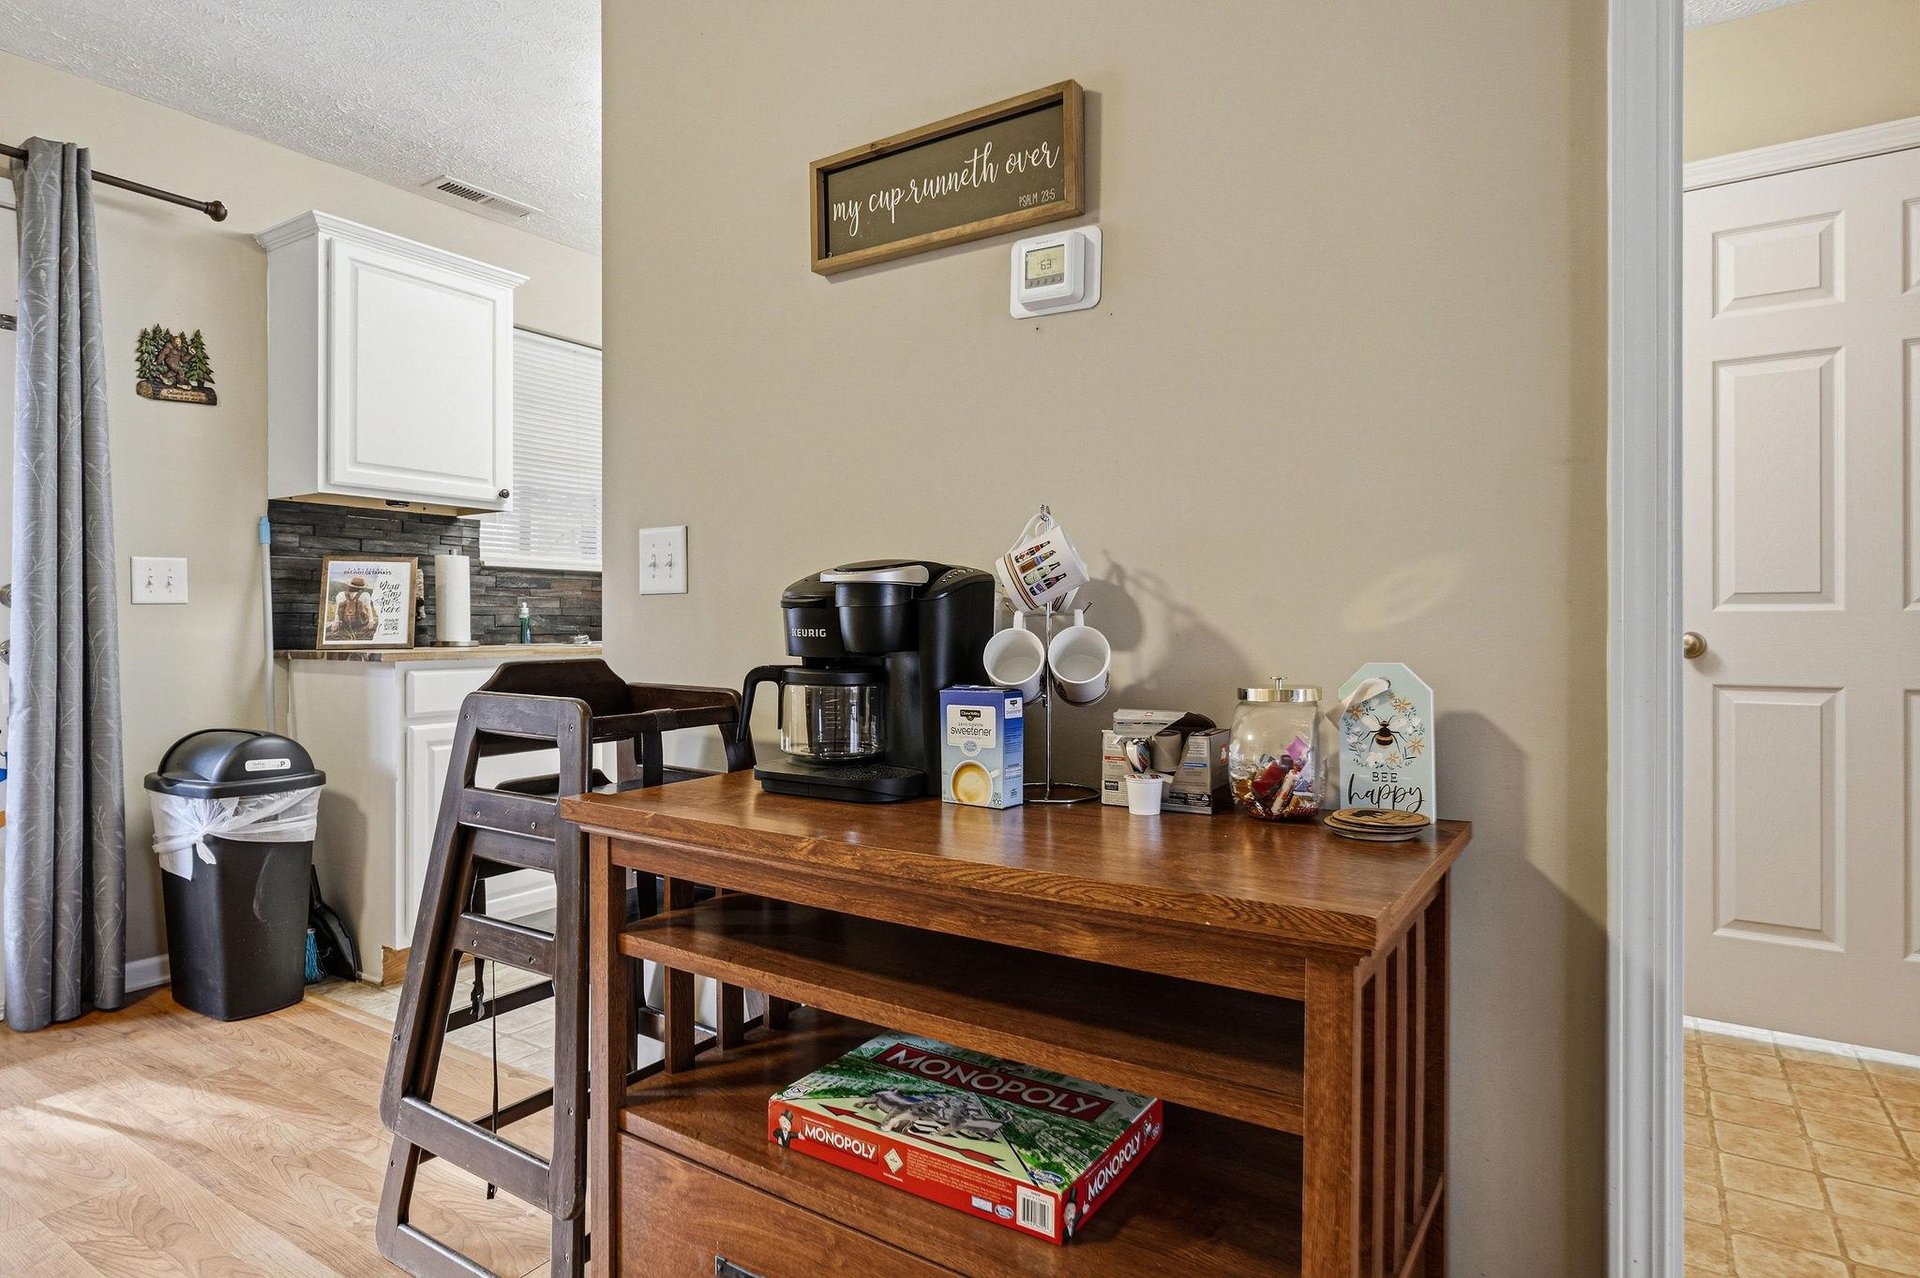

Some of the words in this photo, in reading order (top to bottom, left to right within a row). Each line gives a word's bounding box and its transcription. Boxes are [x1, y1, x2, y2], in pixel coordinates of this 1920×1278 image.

[833, 200, 863, 237] my
[868, 187, 906, 224] cup
[905, 141, 999, 204] runneth
[1005, 141, 1060, 174] over
[1018, 192, 1038, 207] PSALM
[791, 627, 827, 638] KEURIG
[1348, 773, 1425, 813] happy
[1371, 771, 1398, 783] BEE
[886, 1049, 1101, 1114] MONOPOLY
[804, 1122, 877, 1160] MONOPOLY
[1087, 1131, 1141, 1203] MONOPOLY
